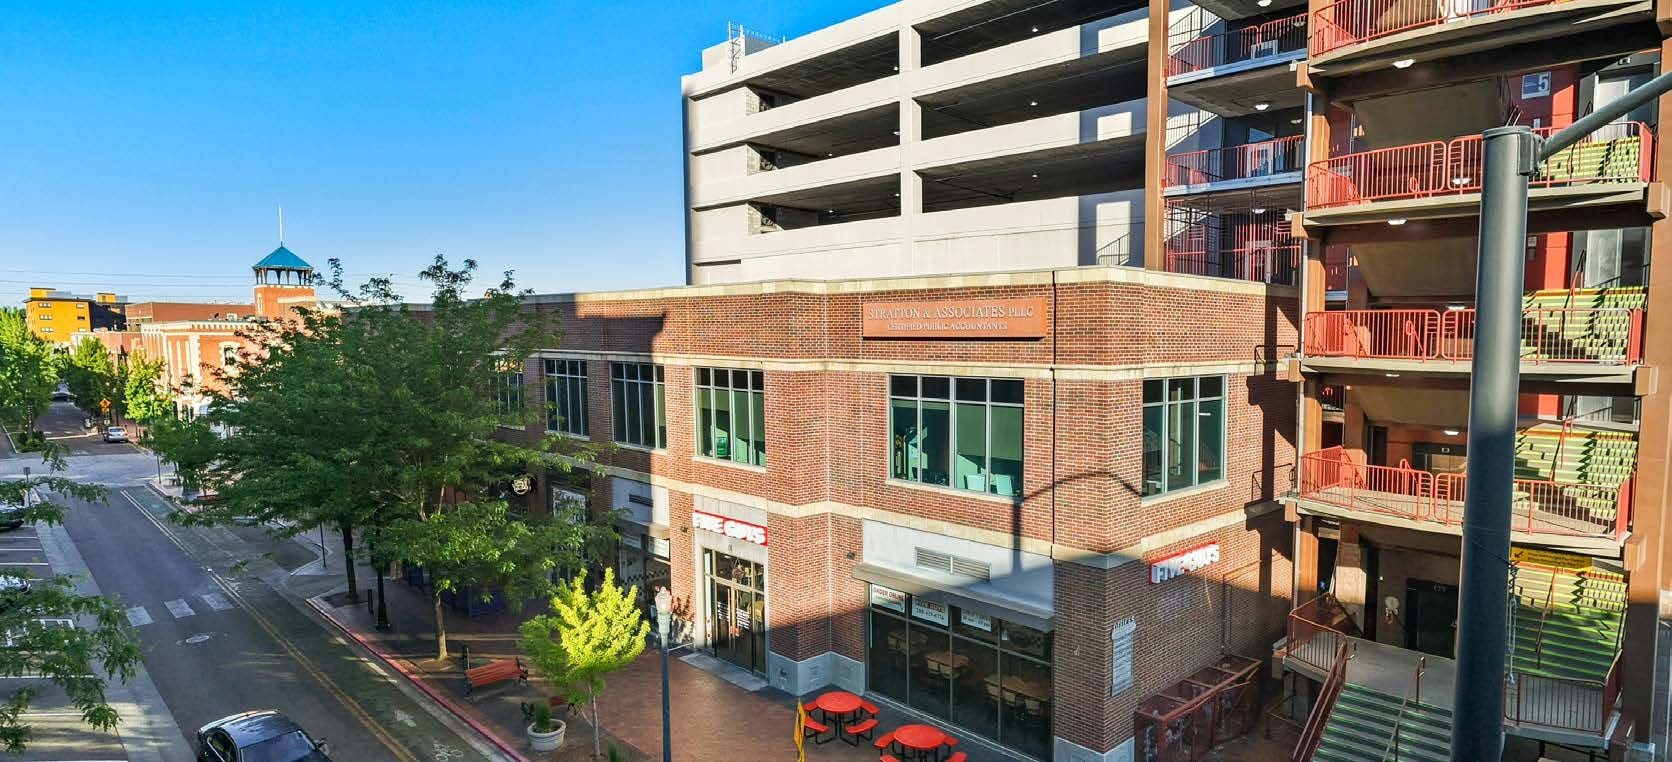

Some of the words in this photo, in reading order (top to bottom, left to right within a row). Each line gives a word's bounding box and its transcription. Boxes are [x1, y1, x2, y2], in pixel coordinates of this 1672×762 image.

[1538, 73, 1549, 92] 5
[923, 308, 930, 319] &
[935, 305, 1006, 319] ASSOCIATES
[1008, 306, 1034, 318] PLLC
[950, 321, 1008, 331] ACCOUNTANTS
[1152, 555, 1185, 584] FIVE
[872, 586, 888, 597] ORDER
